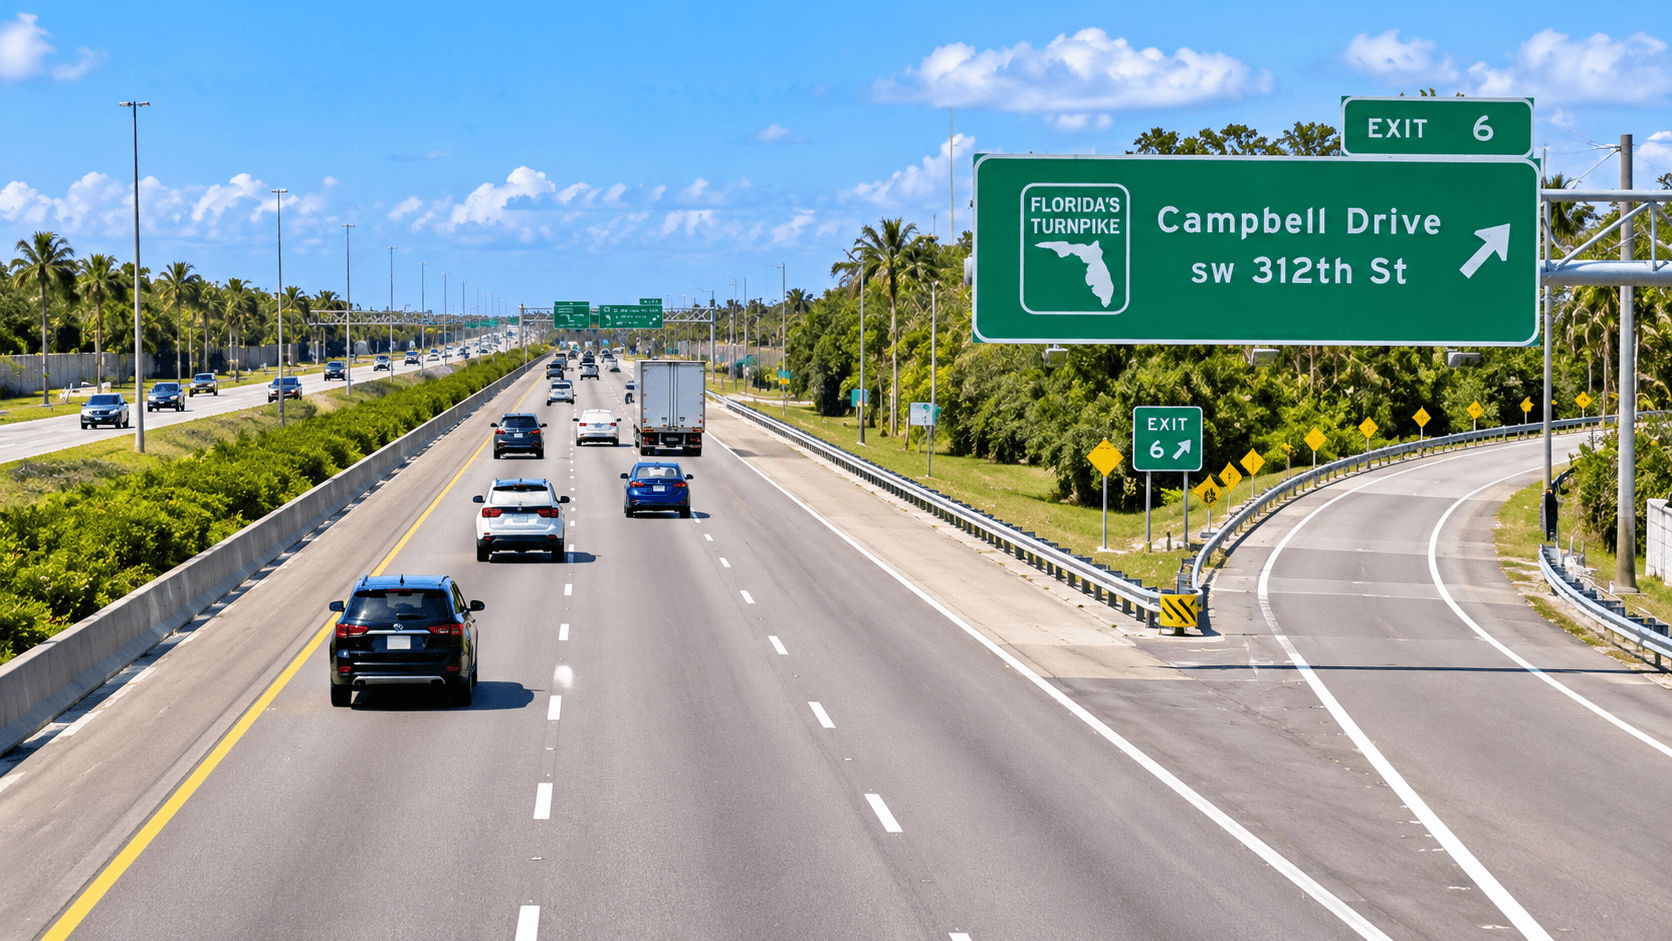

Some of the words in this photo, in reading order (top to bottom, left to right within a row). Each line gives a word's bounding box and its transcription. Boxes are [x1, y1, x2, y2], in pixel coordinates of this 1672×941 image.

[1368, 118, 1428, 138] EXIT
[1472, 115, 1494, 142] 6
[1031, 196, 1121, 213] FLORIDA'S
[1031, 218, 1120, 234] TURNPIKE
[1157, 206, 1326, 241] Campbell
[1347, 207, 1441, 235] Drive
[1252, 256, 1352, 284] 312th
[1369, 257, 1407, 285] St
[1147, 417, 1188, 431] EXIT
[1149, 440, 1165, 459] 6
